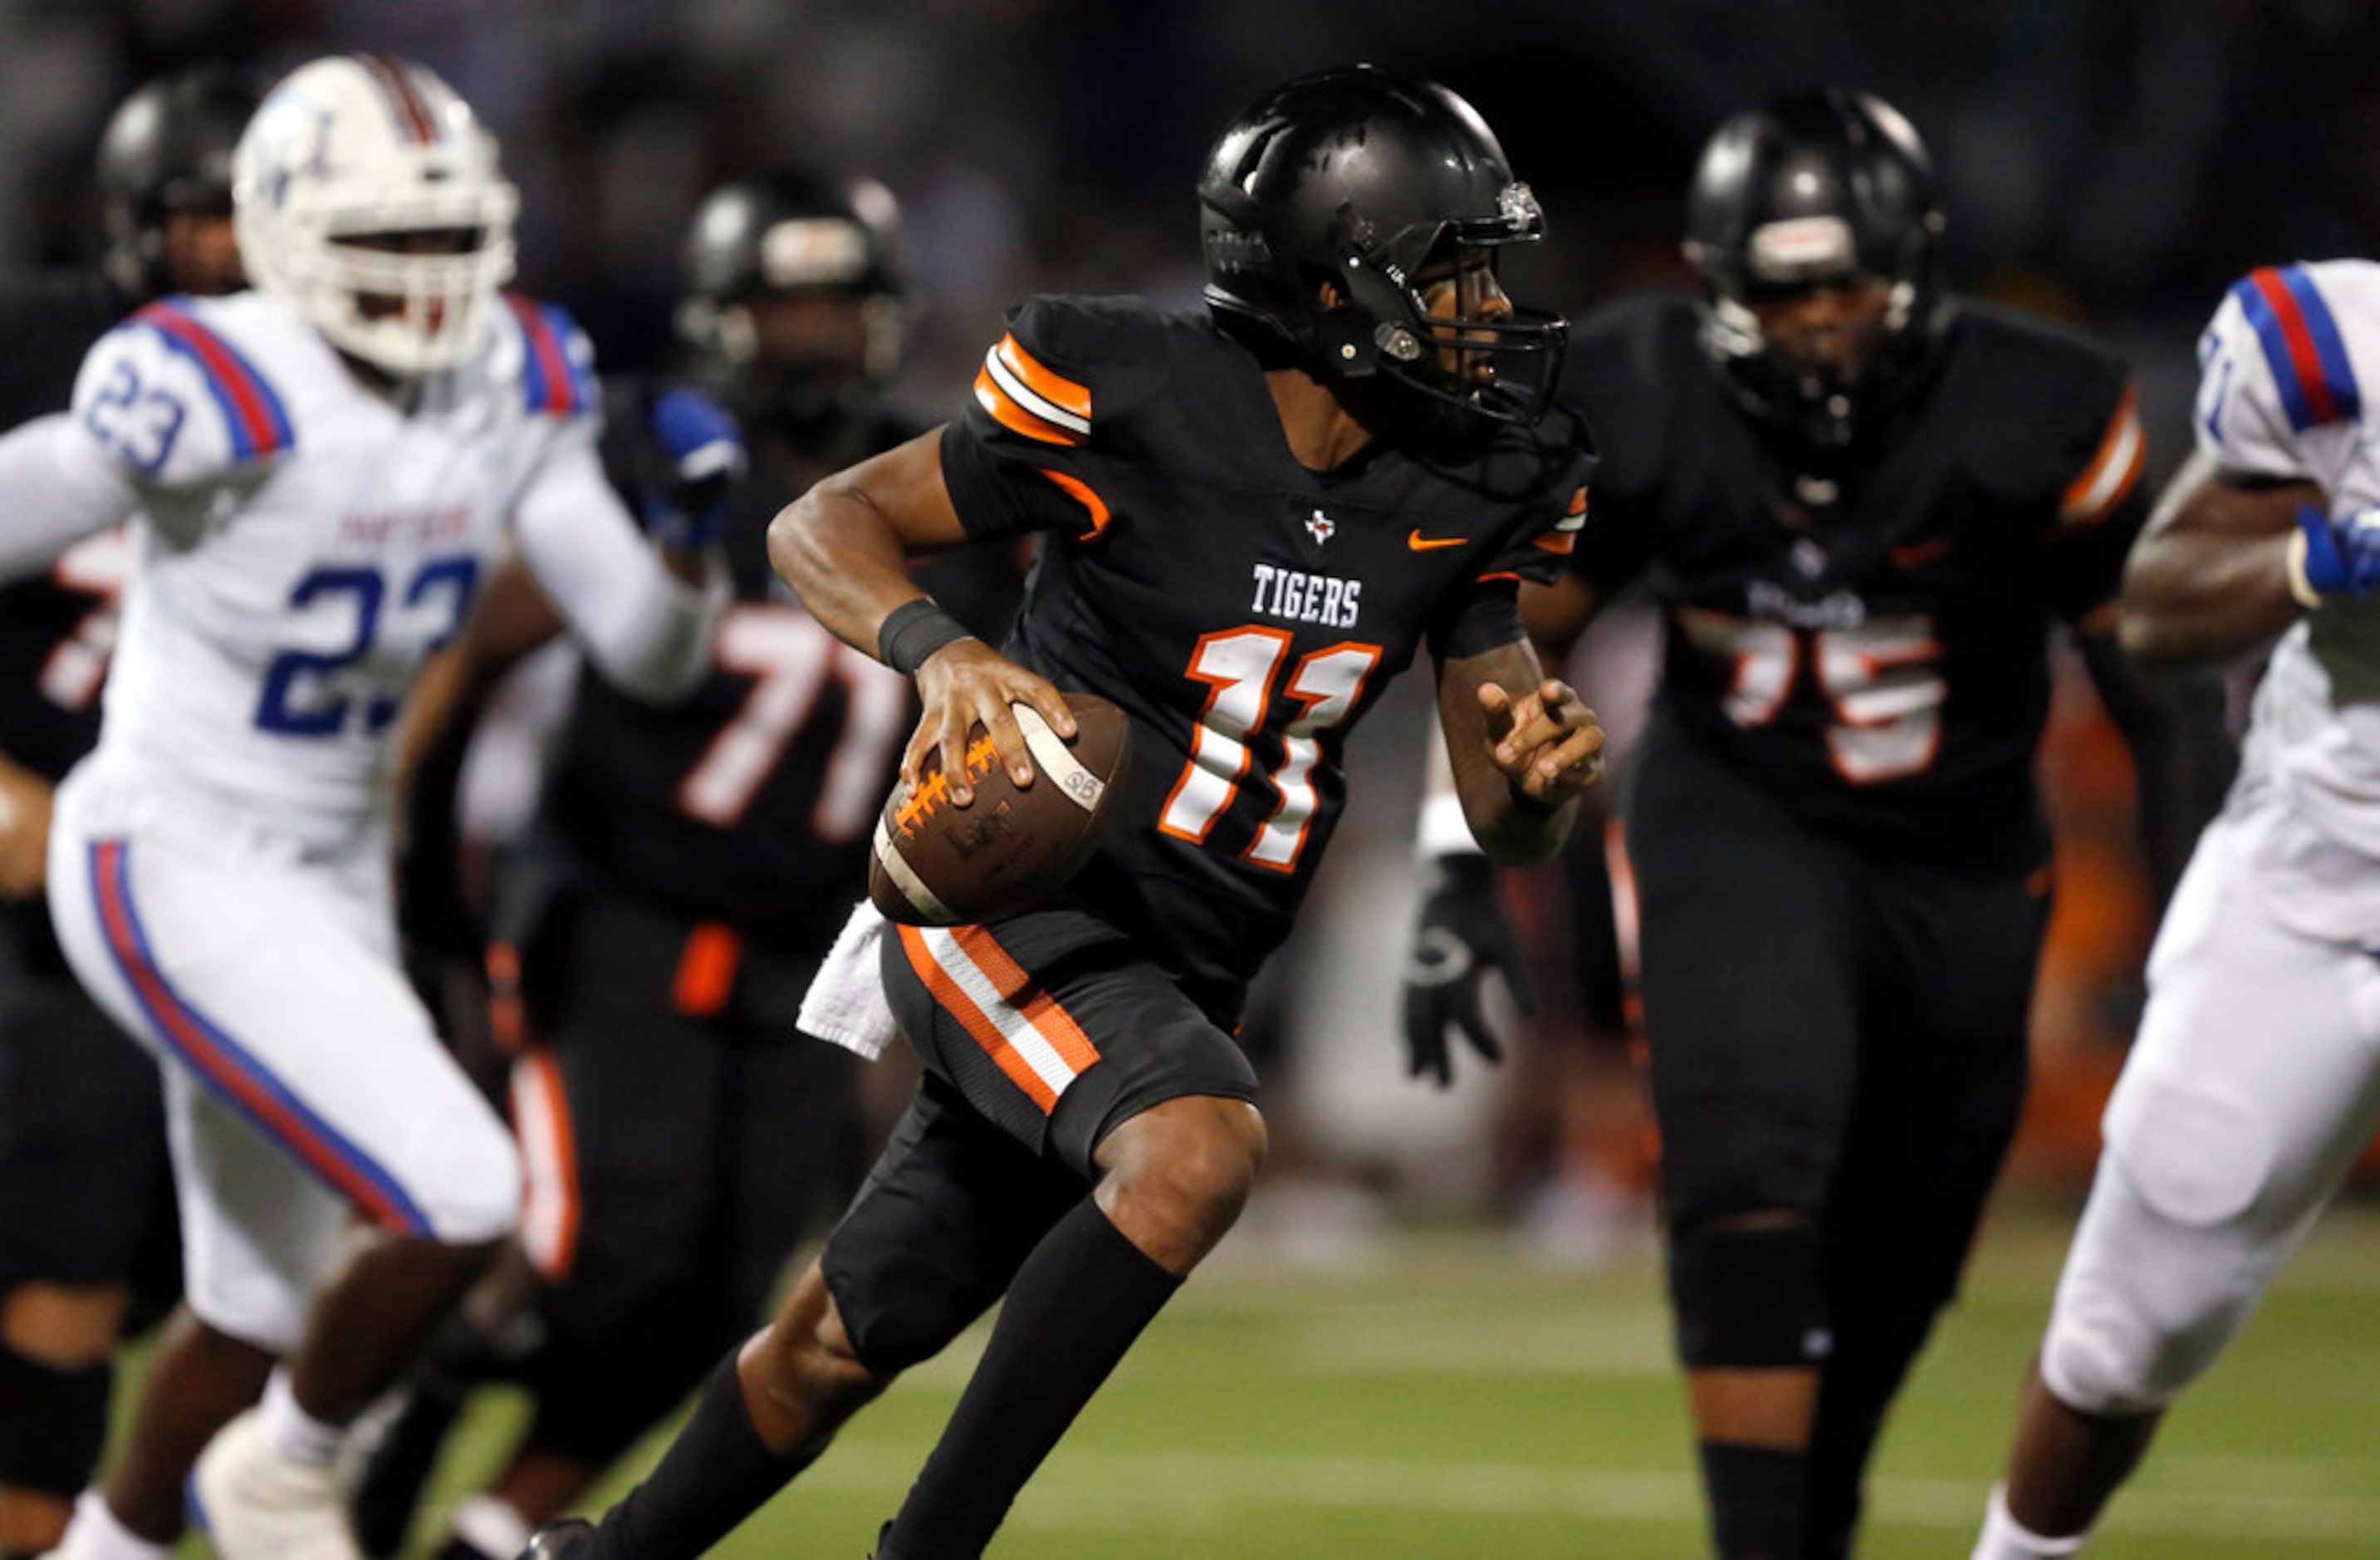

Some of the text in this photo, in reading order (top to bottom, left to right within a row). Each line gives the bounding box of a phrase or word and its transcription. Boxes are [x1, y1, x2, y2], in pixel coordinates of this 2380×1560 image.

[84, 357, 191, 476] 23
[1251, 563, 1362, 629] TIGERS
[1157, 624, 1383, 875] 11
